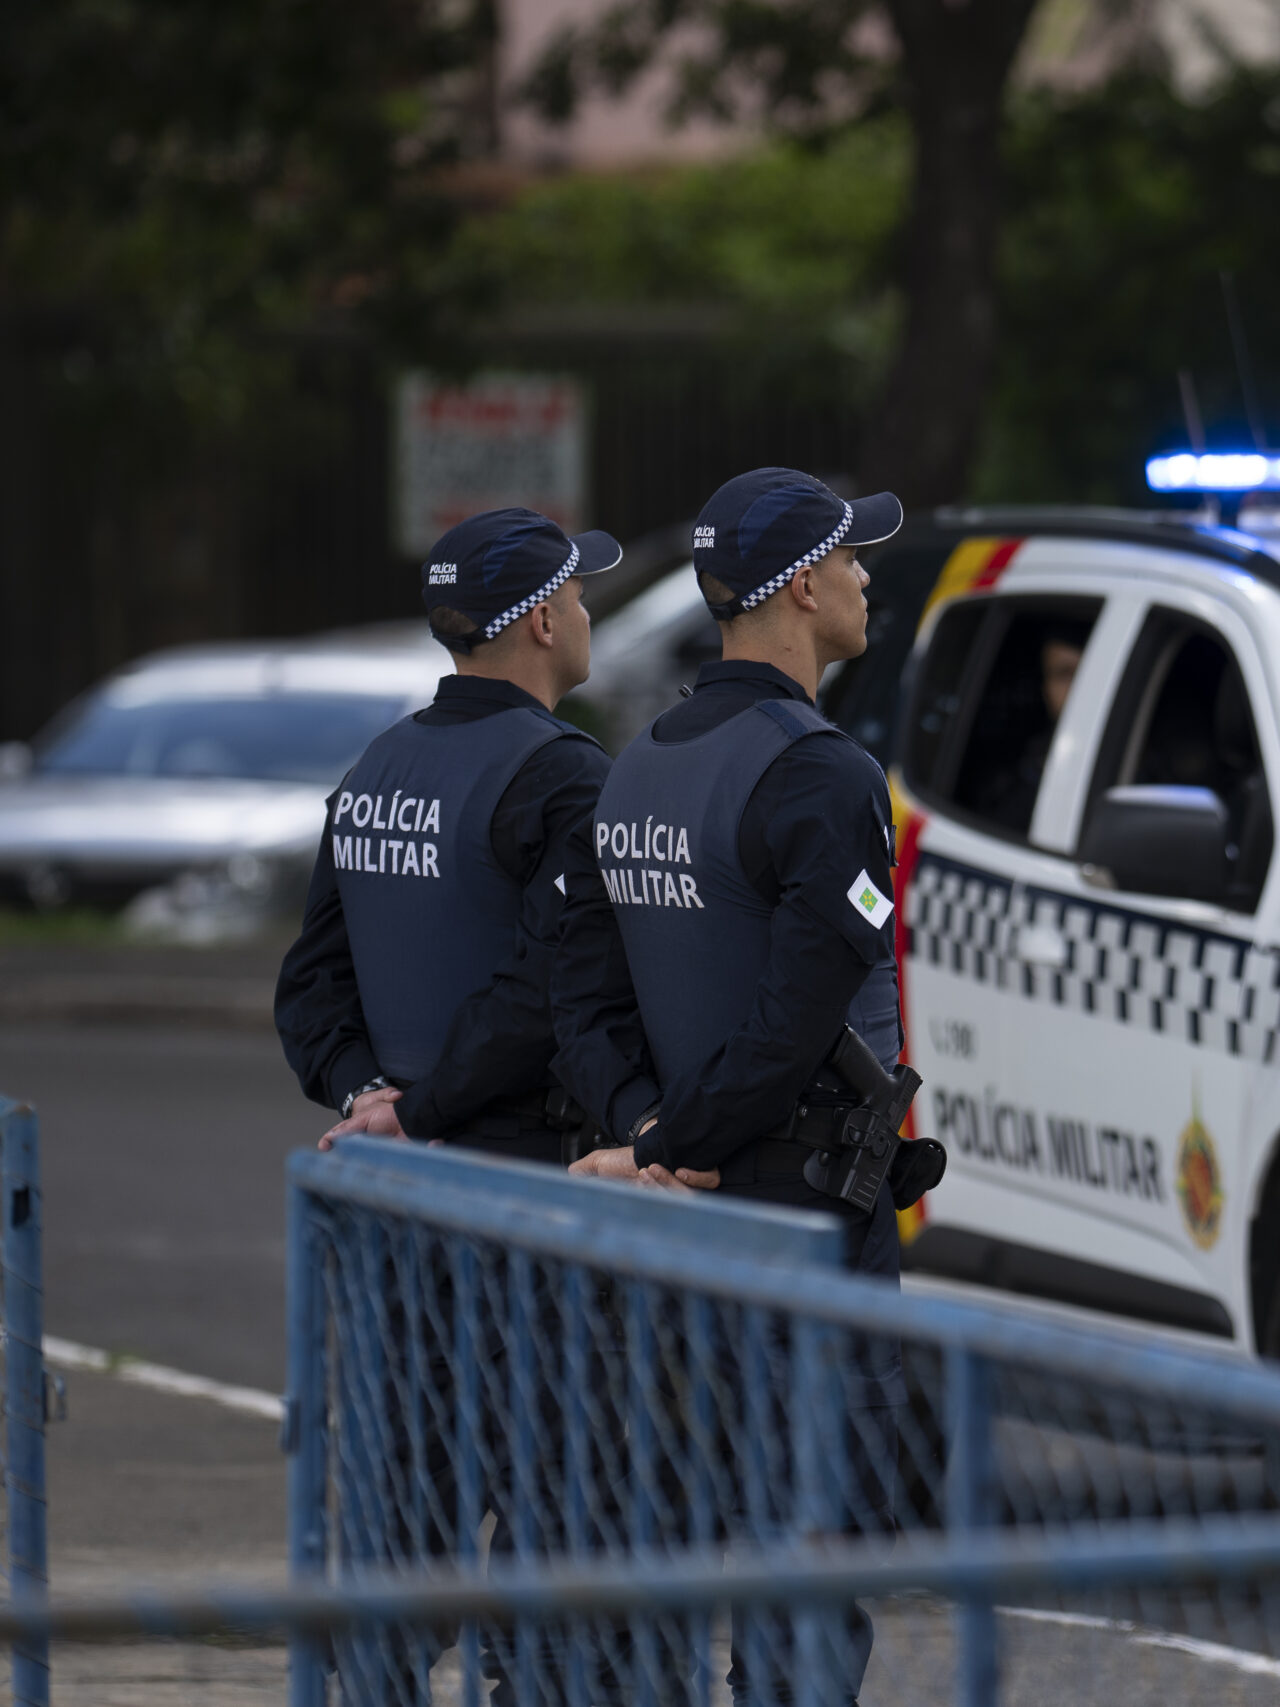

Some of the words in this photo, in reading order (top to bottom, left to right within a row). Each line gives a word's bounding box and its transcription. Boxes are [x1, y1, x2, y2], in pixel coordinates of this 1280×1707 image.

[693, 524, 715, 538] POLÍCIA
[428, 574, 457, 585] MILITAR
[430, 562, 457, 574] POLÍCIA
[334, 790, 440, 834] POLÍCIA
[333, 834, 440, 878] MILITAR
[597, 815, 692, 864] POLÍCIA
[601, 868, 705, 909] MILITAR
[934, 1084, 1040, 1170] POLÍCIA
[1046, 1114, 1164, 1202] MILITAR
